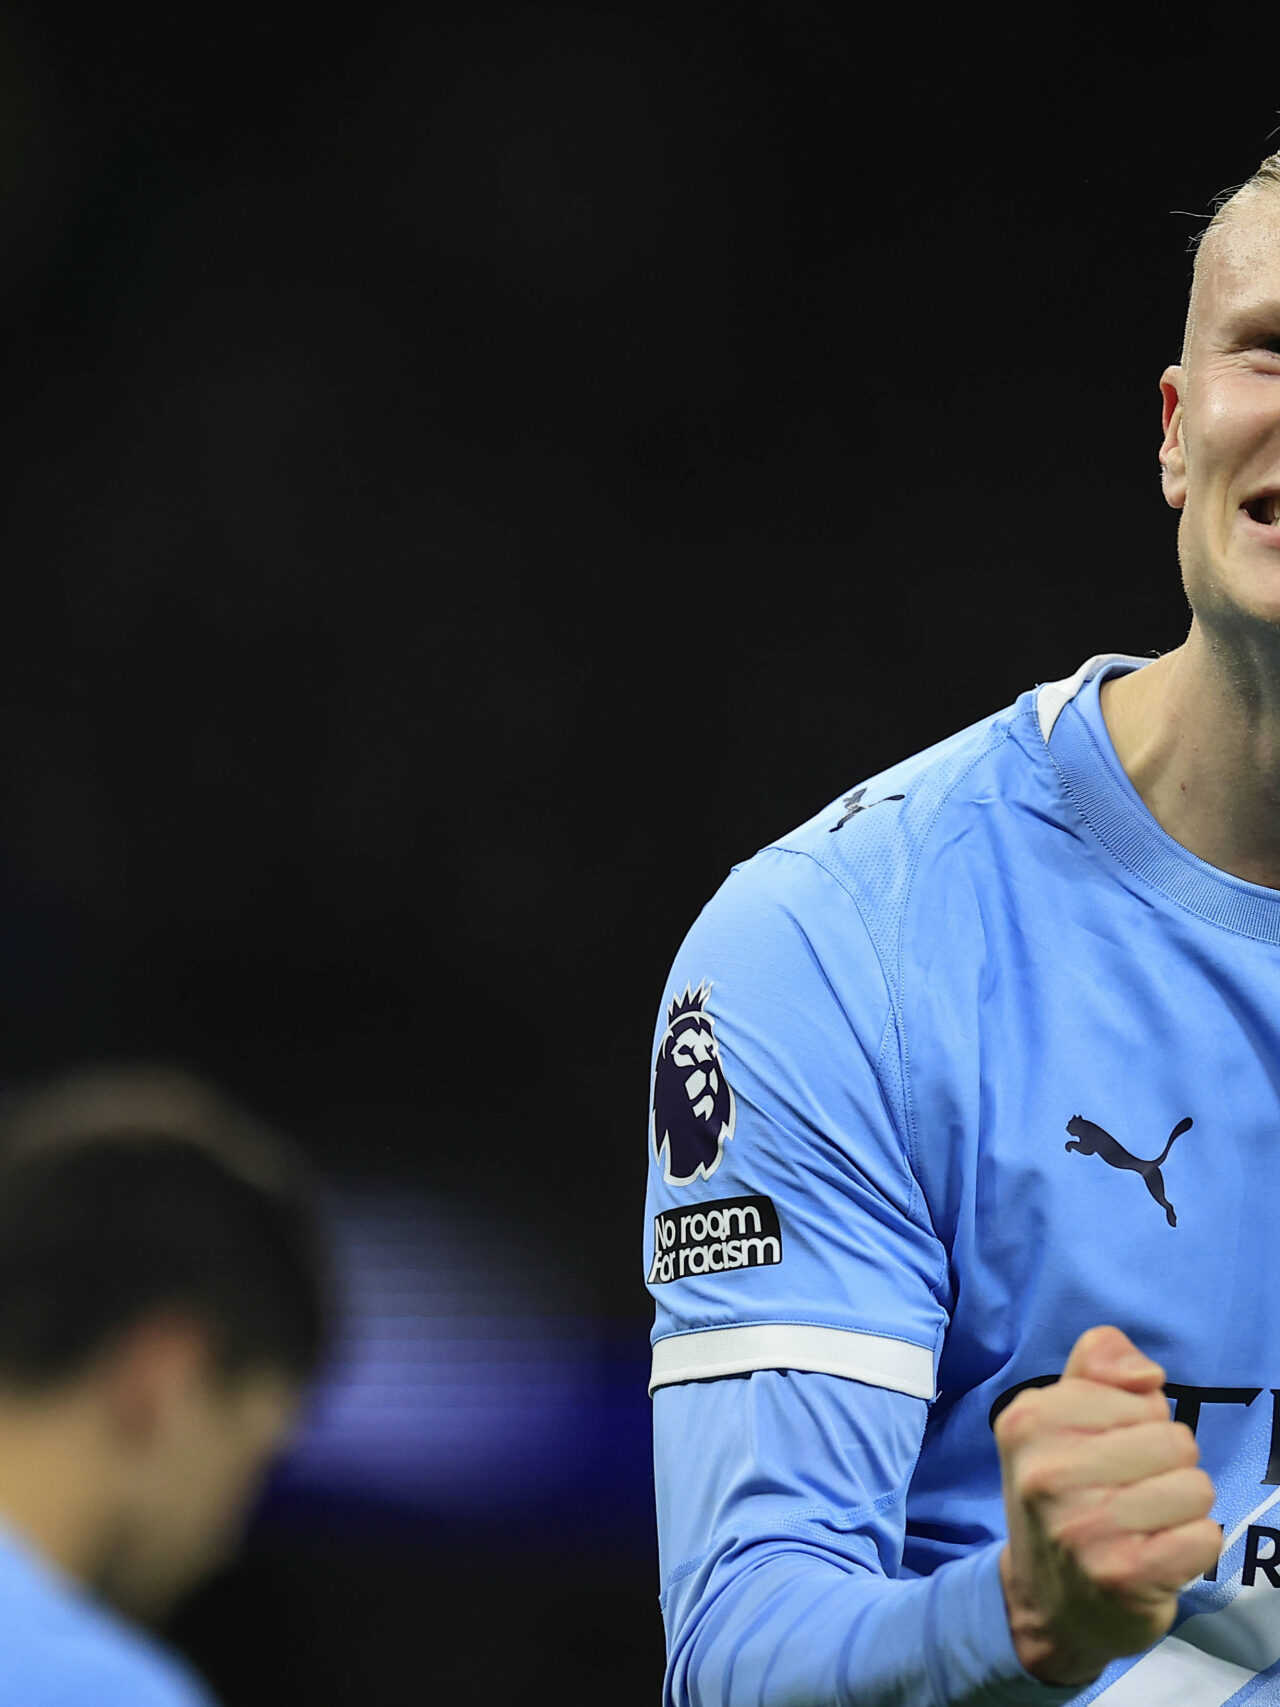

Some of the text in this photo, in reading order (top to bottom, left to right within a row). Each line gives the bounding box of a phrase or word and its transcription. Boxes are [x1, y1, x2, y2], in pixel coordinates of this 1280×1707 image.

[655, 1205, 762, 1252] No room
[678, 1235, 781, 1277] racism
